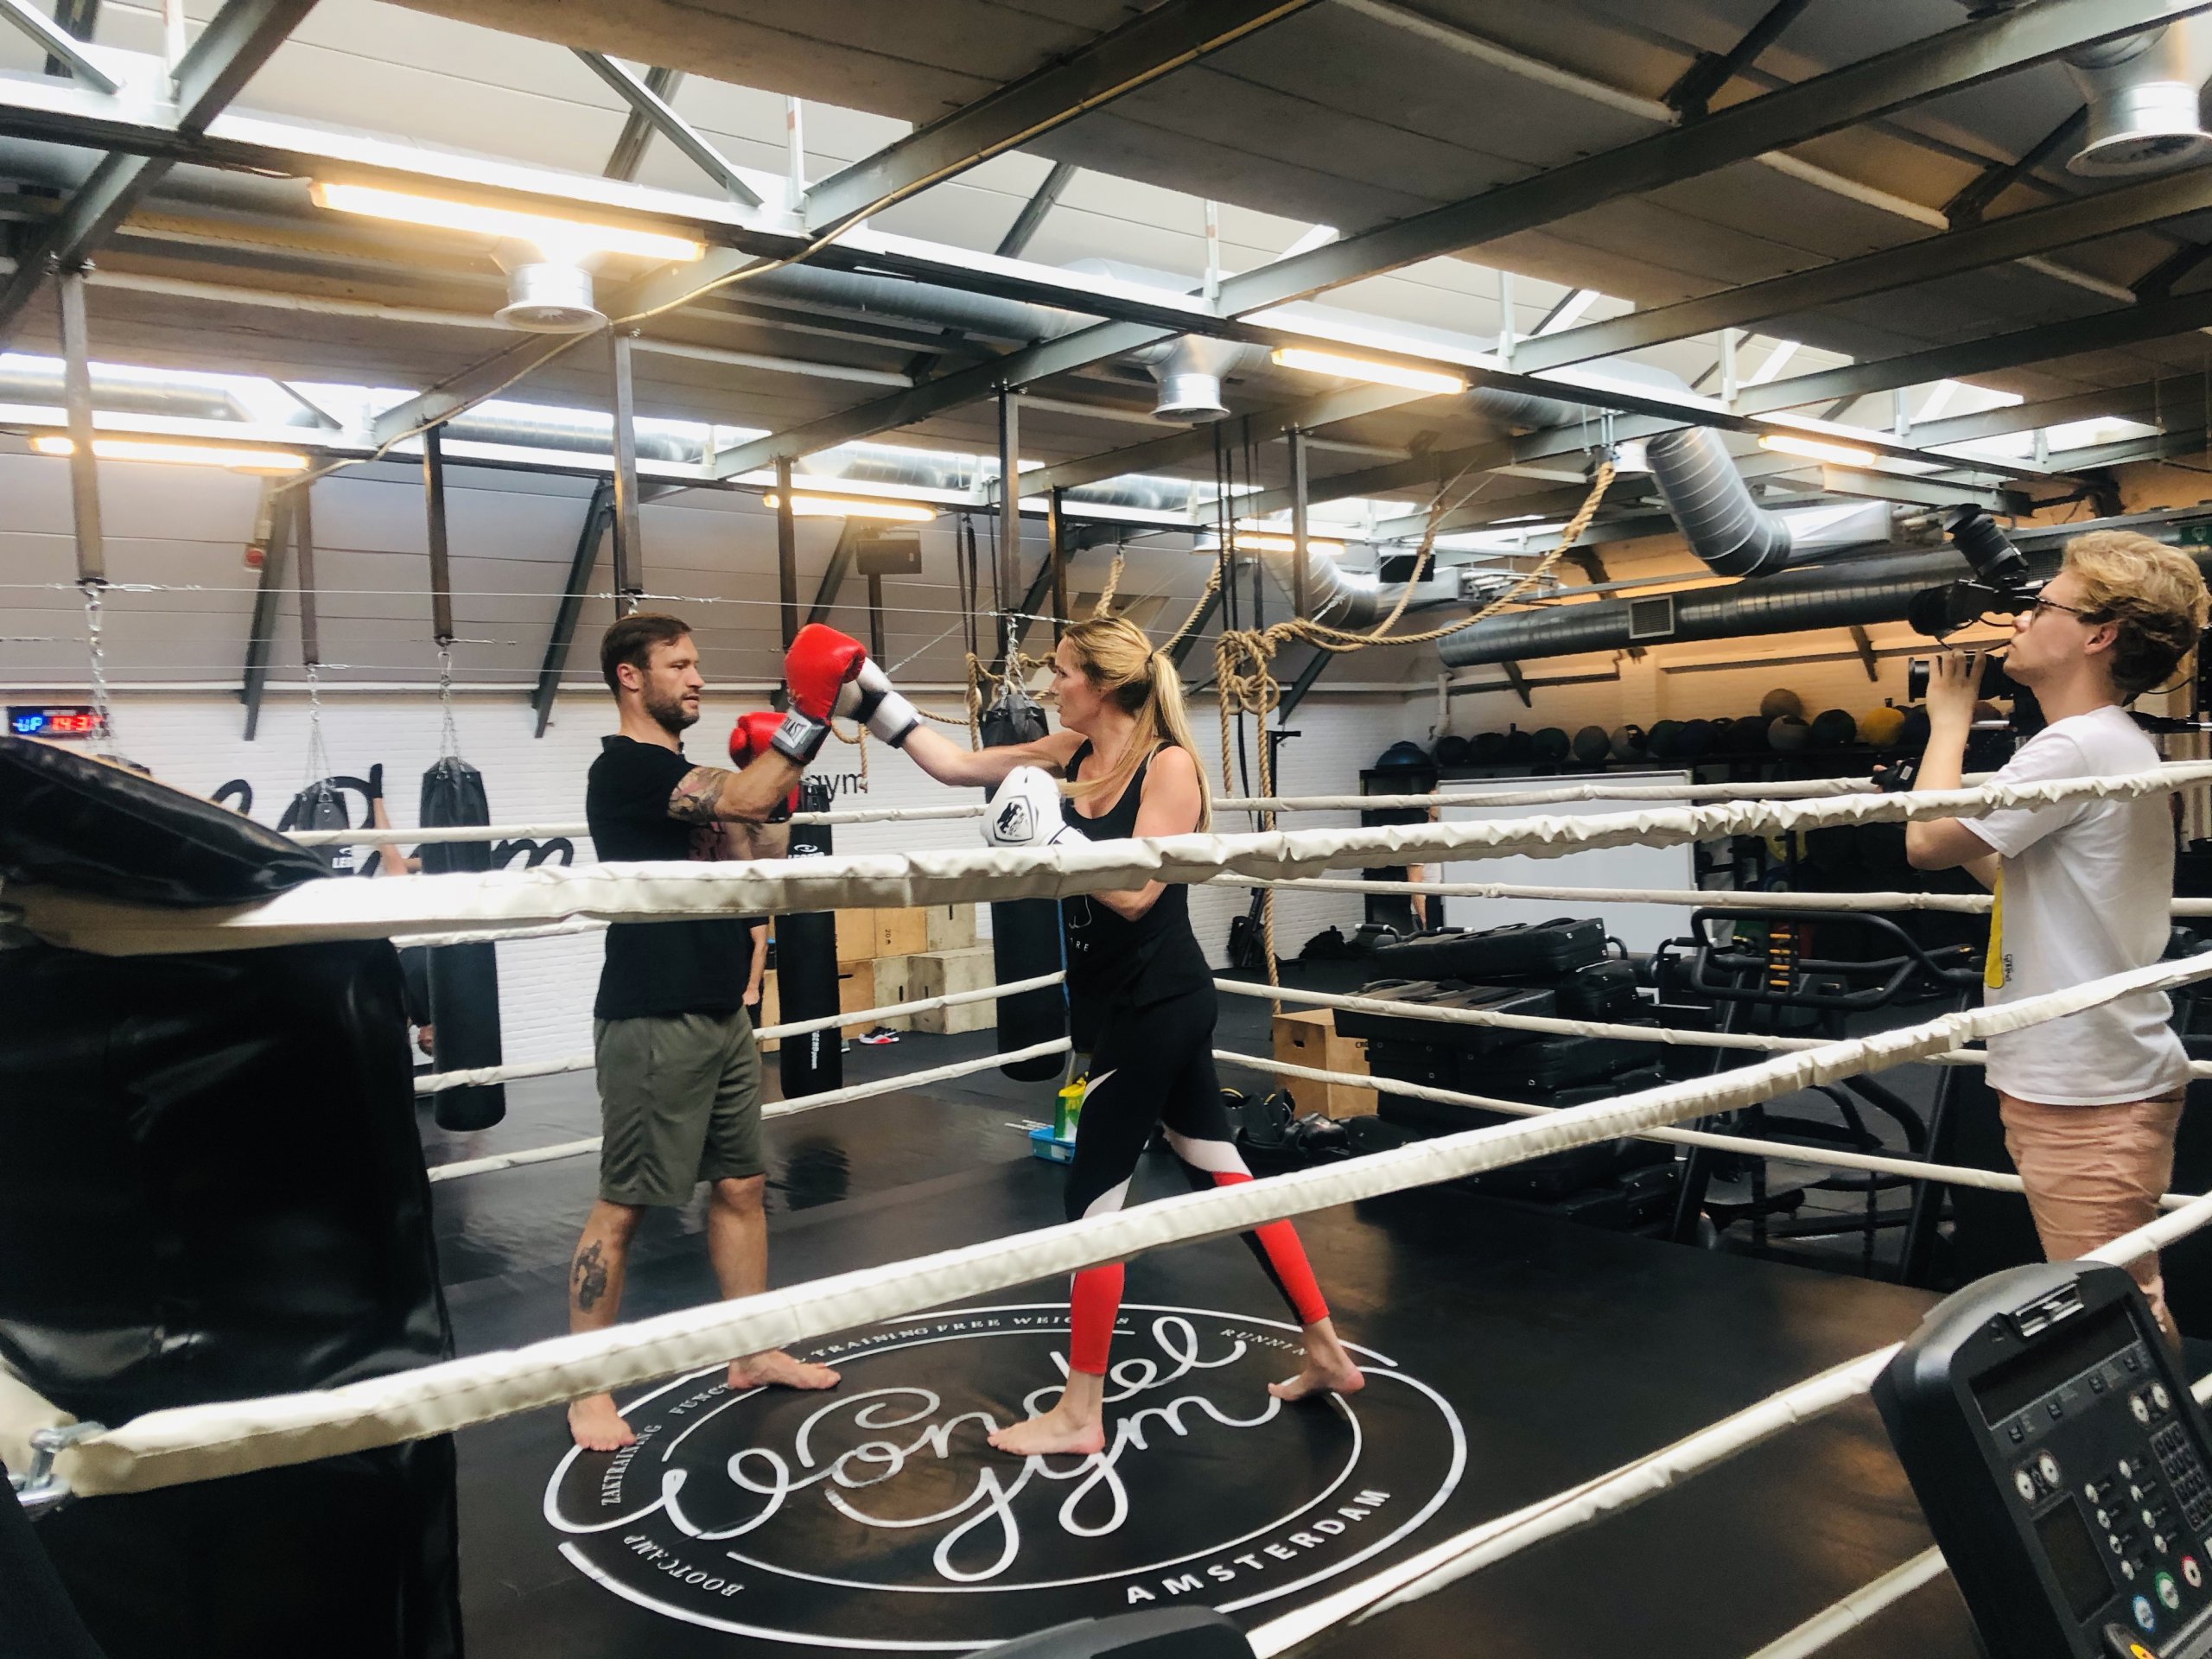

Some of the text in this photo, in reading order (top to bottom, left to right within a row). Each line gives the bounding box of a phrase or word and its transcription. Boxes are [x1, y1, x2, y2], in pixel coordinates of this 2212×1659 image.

[811, 1325, 930, 1357] TRAINING
[937, 1319, 1001, 1333] FREE
[1220, 1328, 1308, 1357] RUNNIN
[623, 1535, 746, 1597] BOOTCAMP
[1127, 1488, 1391, 1605] AMSTERDAM
